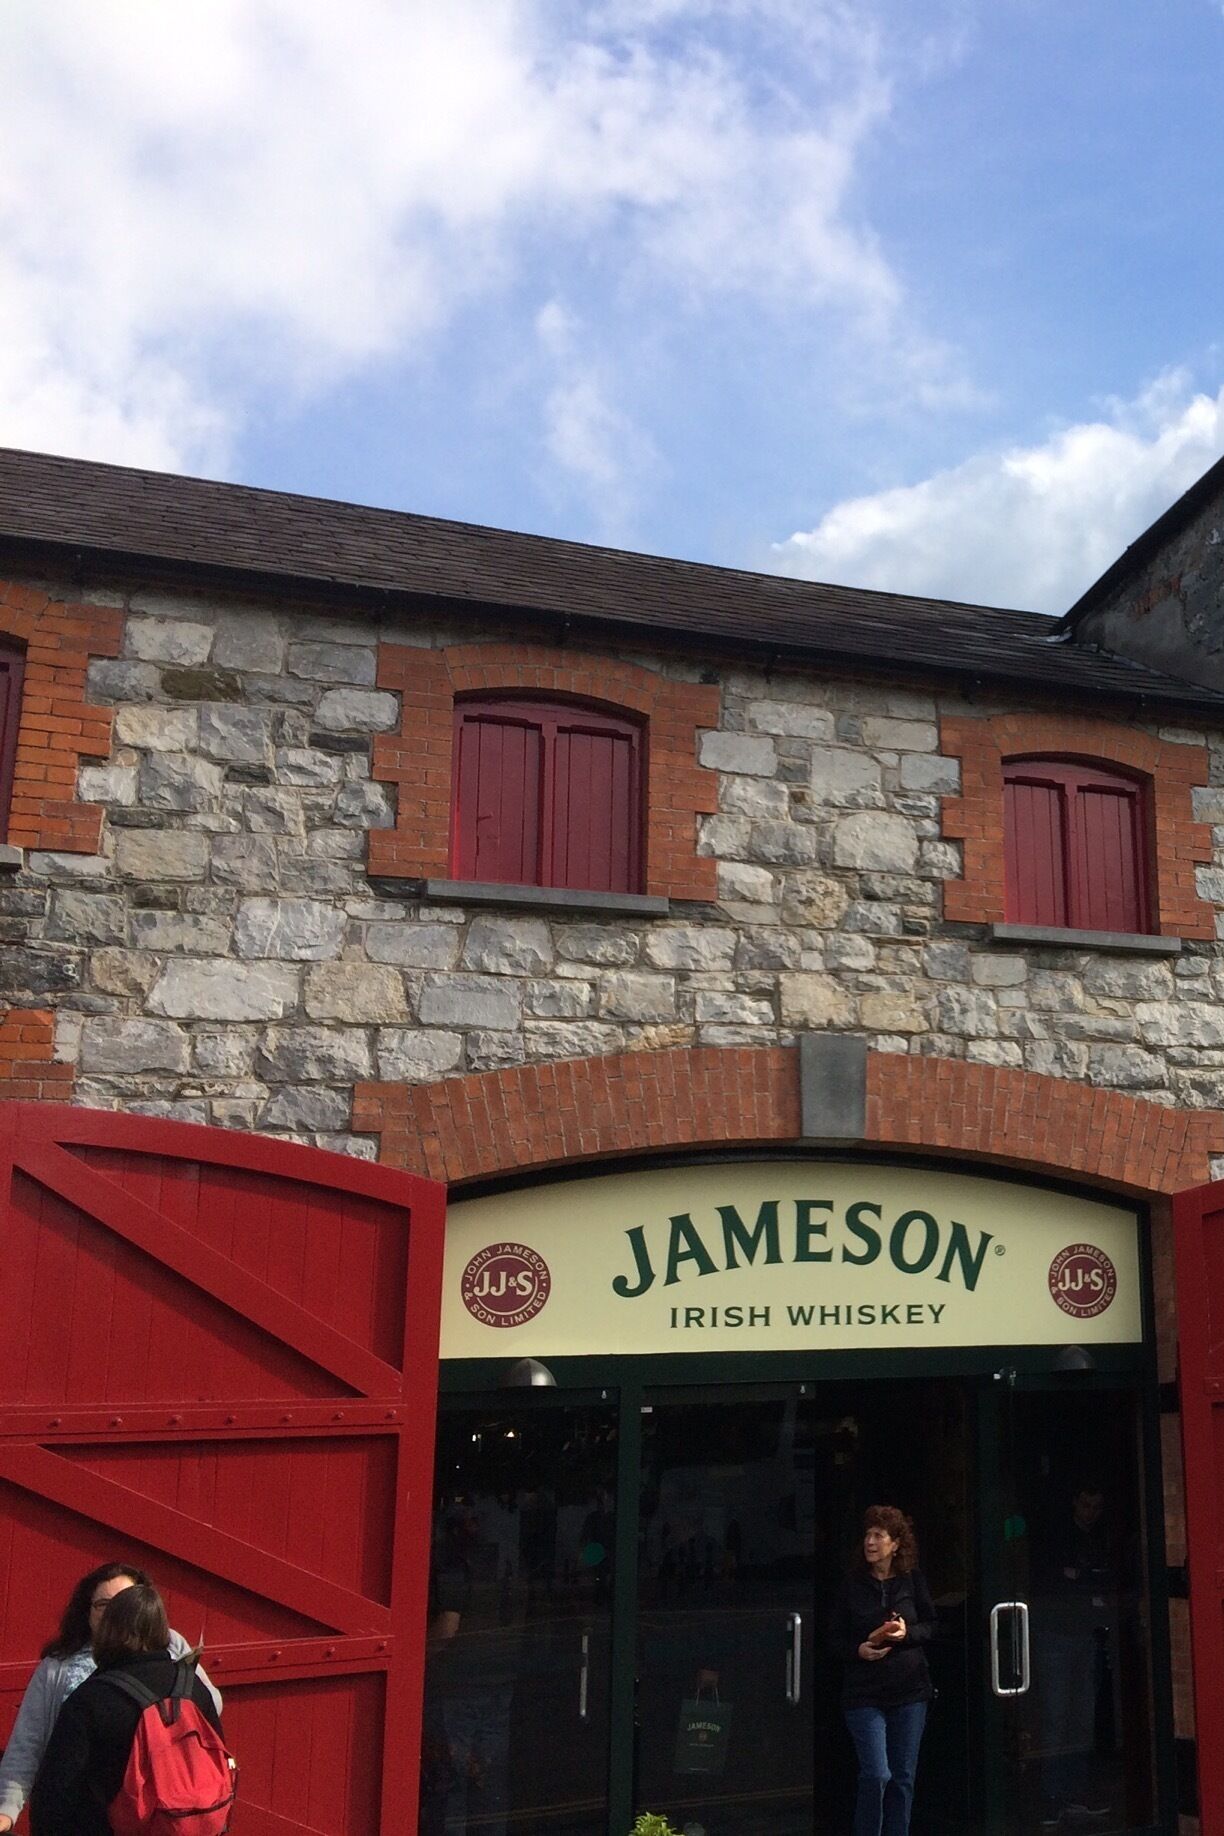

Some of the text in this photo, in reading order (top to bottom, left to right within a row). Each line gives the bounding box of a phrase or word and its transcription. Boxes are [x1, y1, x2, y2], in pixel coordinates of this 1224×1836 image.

[465, 1245, 548, 1281] JOHN JAMESON
[612, 1199, 995, 1298] JAMESON
[1050, 1246, 1114, 1277] JOHN JAMESON
[473, 1270, 533, 1297] JJ&S
[1058, 1268, 1103, 1291] JJ&S
[464, 1291, 546, 1326] & SON LIMITED
[670, 1304, 946, 1329] IRISH WHISKEY
[1057, 1297, 1077, 1315] SON
[1081, 1287, 1114, 1316] LIMITED
